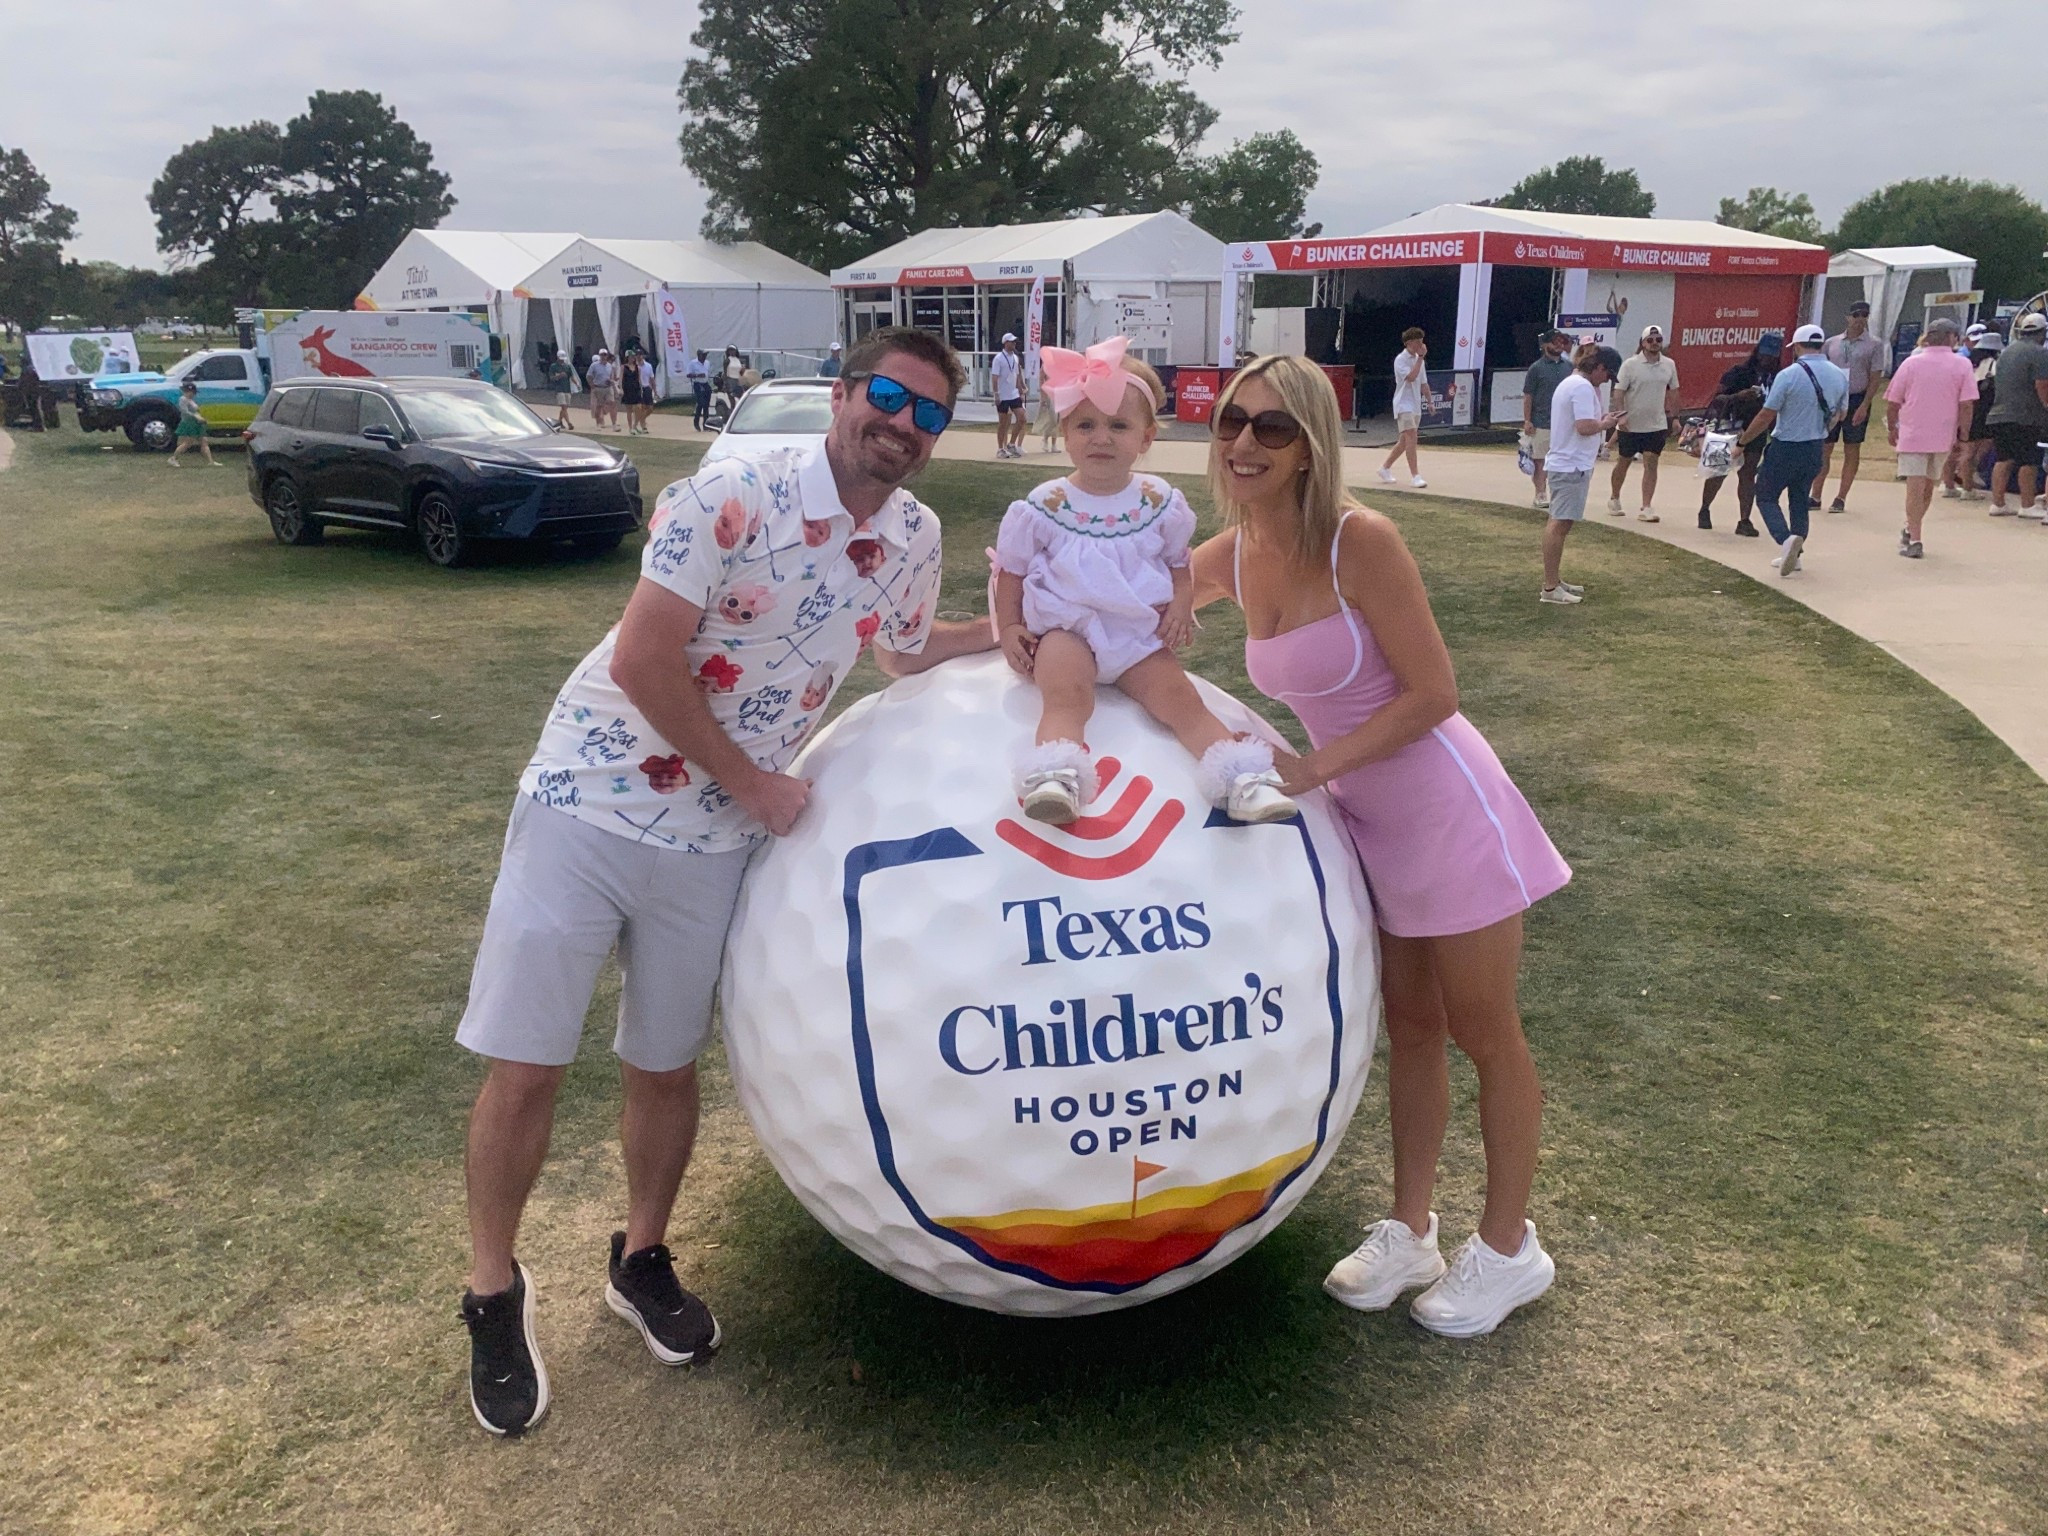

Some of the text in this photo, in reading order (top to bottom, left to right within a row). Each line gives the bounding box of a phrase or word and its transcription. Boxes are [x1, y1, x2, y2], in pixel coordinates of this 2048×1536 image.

[1306, 240, 1465, 262] BUNKER CHALLENGE
[1527, 243, 1586, 260] Texas Children's
[1622, 249, 1711, 266] BUNKER CHALLENGE
[575, 264, 602, 274] ENTRANCE
[850, 272, 877, 281] FIRST AID
[906, 268, 964, 279] FAMILY CARE ZONE
[1000, 265, 1034, 275] FIRST AID
[402, 287, 438, 300] AT THE TURN
[667, 328, 675, 347] AID
[673, 322, 683, 352] FIRST
[1681, 327, 1725, 346] BUNKER
[350, 343, 437, 351] KANGAROO CREW
[1182, 392, 1215, 400] CHALLENGE
[1187, 385, 1210, 393] BUNKER
[903, 501, 920, 513] est
[666, 520, 693, 543] Best
[652, 538, 690, 565] Dad
[815, 581, 836, 608] Best
[758, 685, 792, 705] Best
[739, 696, 785, 725] Dad
[608, 717, 638, 750] Best
[738, 719, 765, 734] By Par
[577, 745, 588, 760] By
[583, 727, 627, 763] Dad
[538, 768, 575, 788] Best
[1002, 896, 1211, 966] Texas
[938, 972, 1283, 1075] Children's
[1013, 1069, 1243, 1124] HOUSTON
[1069, 1115, 1197, 1156] OPEN
